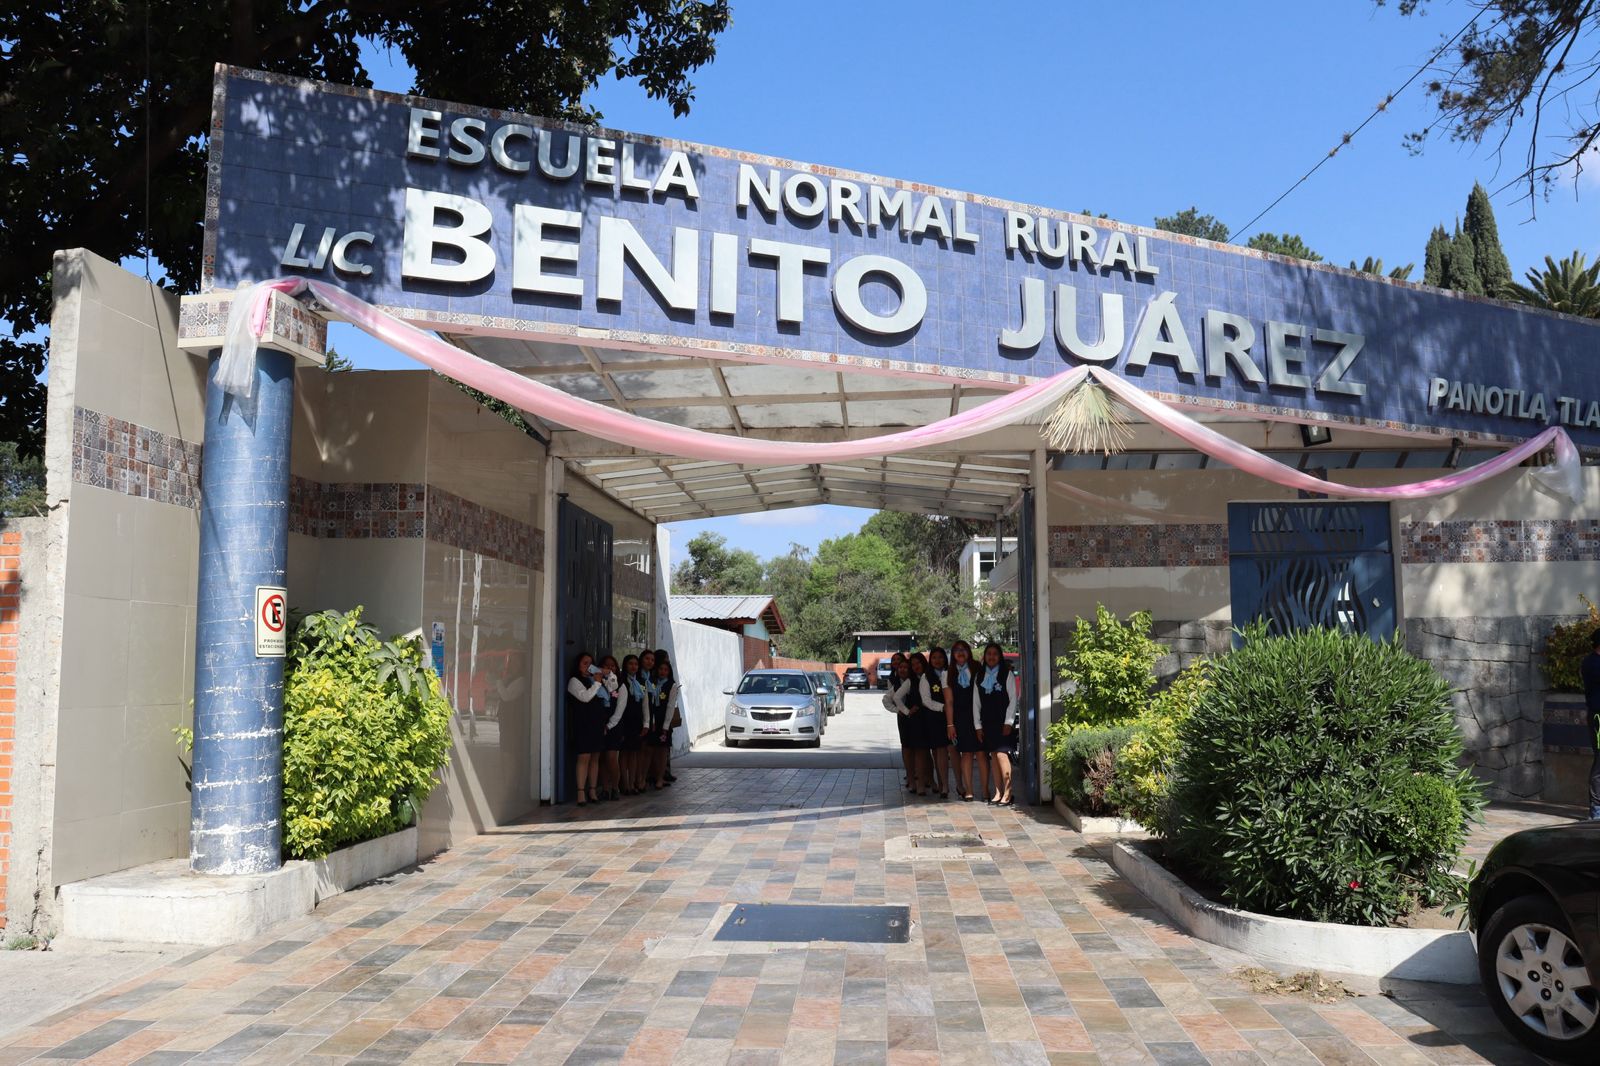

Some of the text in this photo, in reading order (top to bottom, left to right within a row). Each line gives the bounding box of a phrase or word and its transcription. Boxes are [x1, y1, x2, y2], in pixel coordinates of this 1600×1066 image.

[407, 107, 1160, 275] ESCUELA NORMAL RURAL
[280, 187, 1367, 396] LIC. BENITO JUÁREZ
